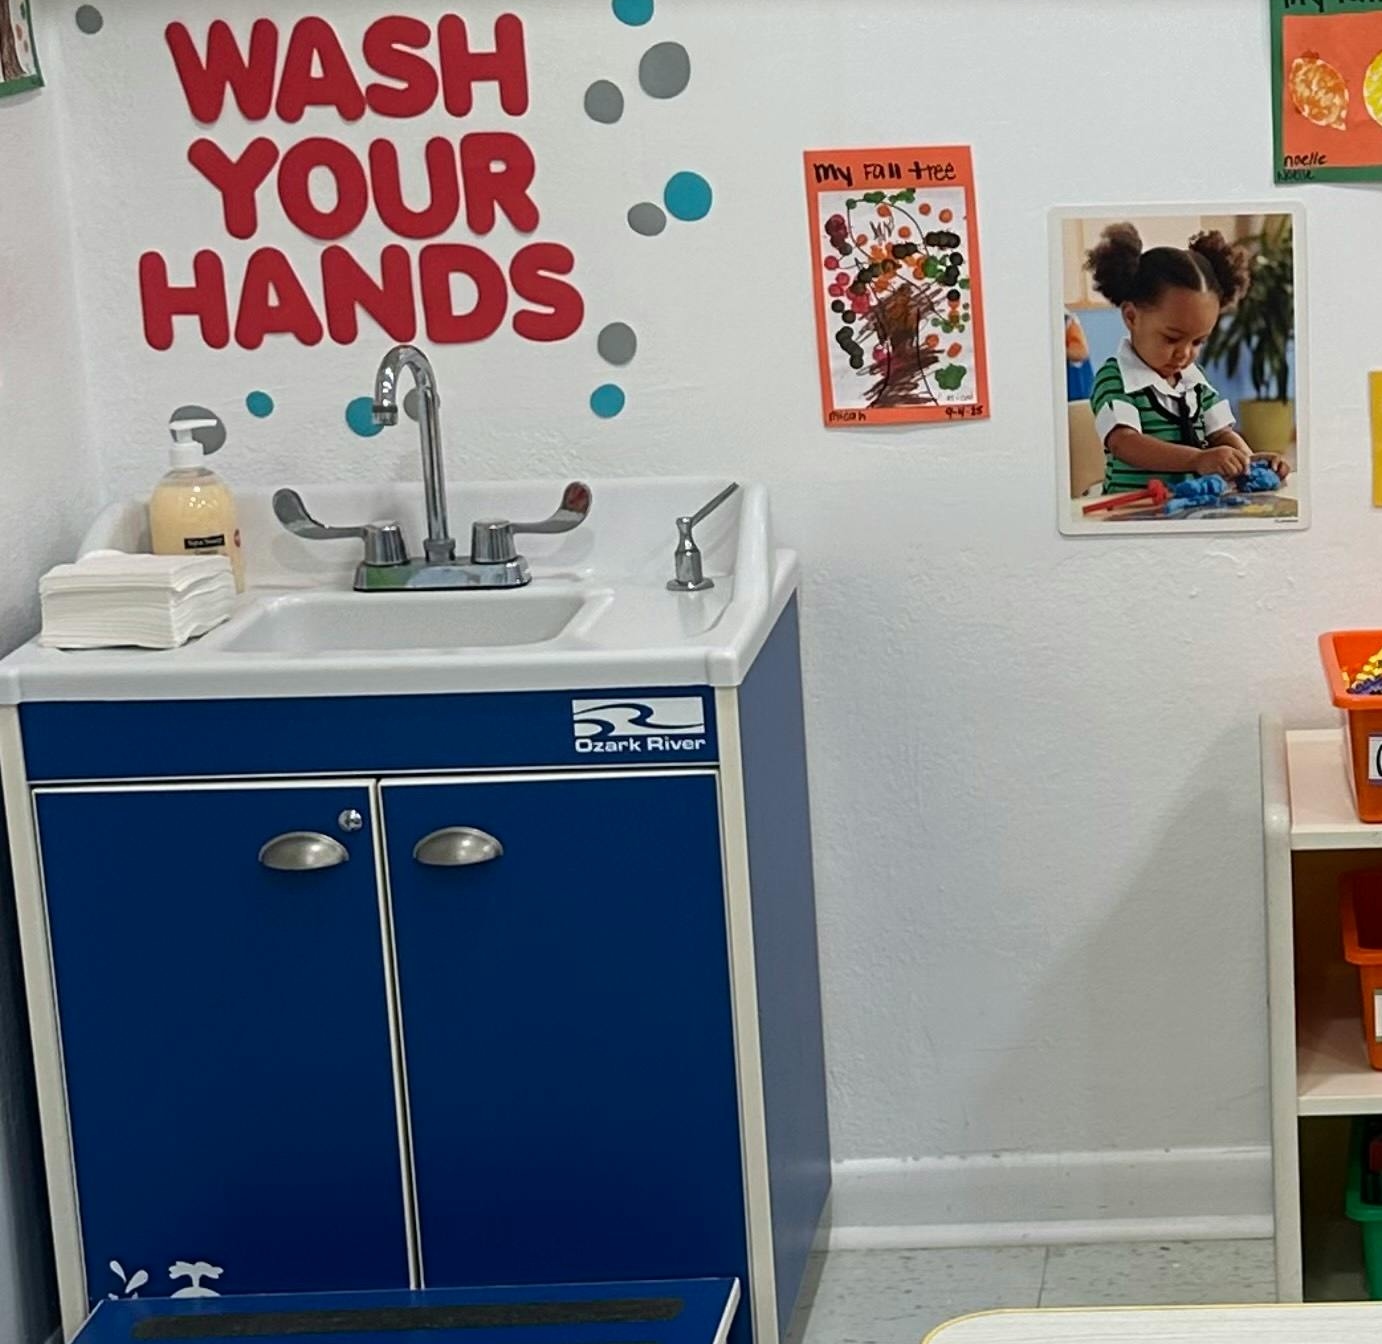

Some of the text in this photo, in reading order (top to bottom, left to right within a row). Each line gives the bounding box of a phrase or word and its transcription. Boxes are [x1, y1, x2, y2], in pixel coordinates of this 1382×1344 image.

[165, 12, 530, 124] WASH
[187, 131, 540, 240] YOUR
[138, 241, 585, 351] HANDS
[574, 735, 707, 753] Ozark River
